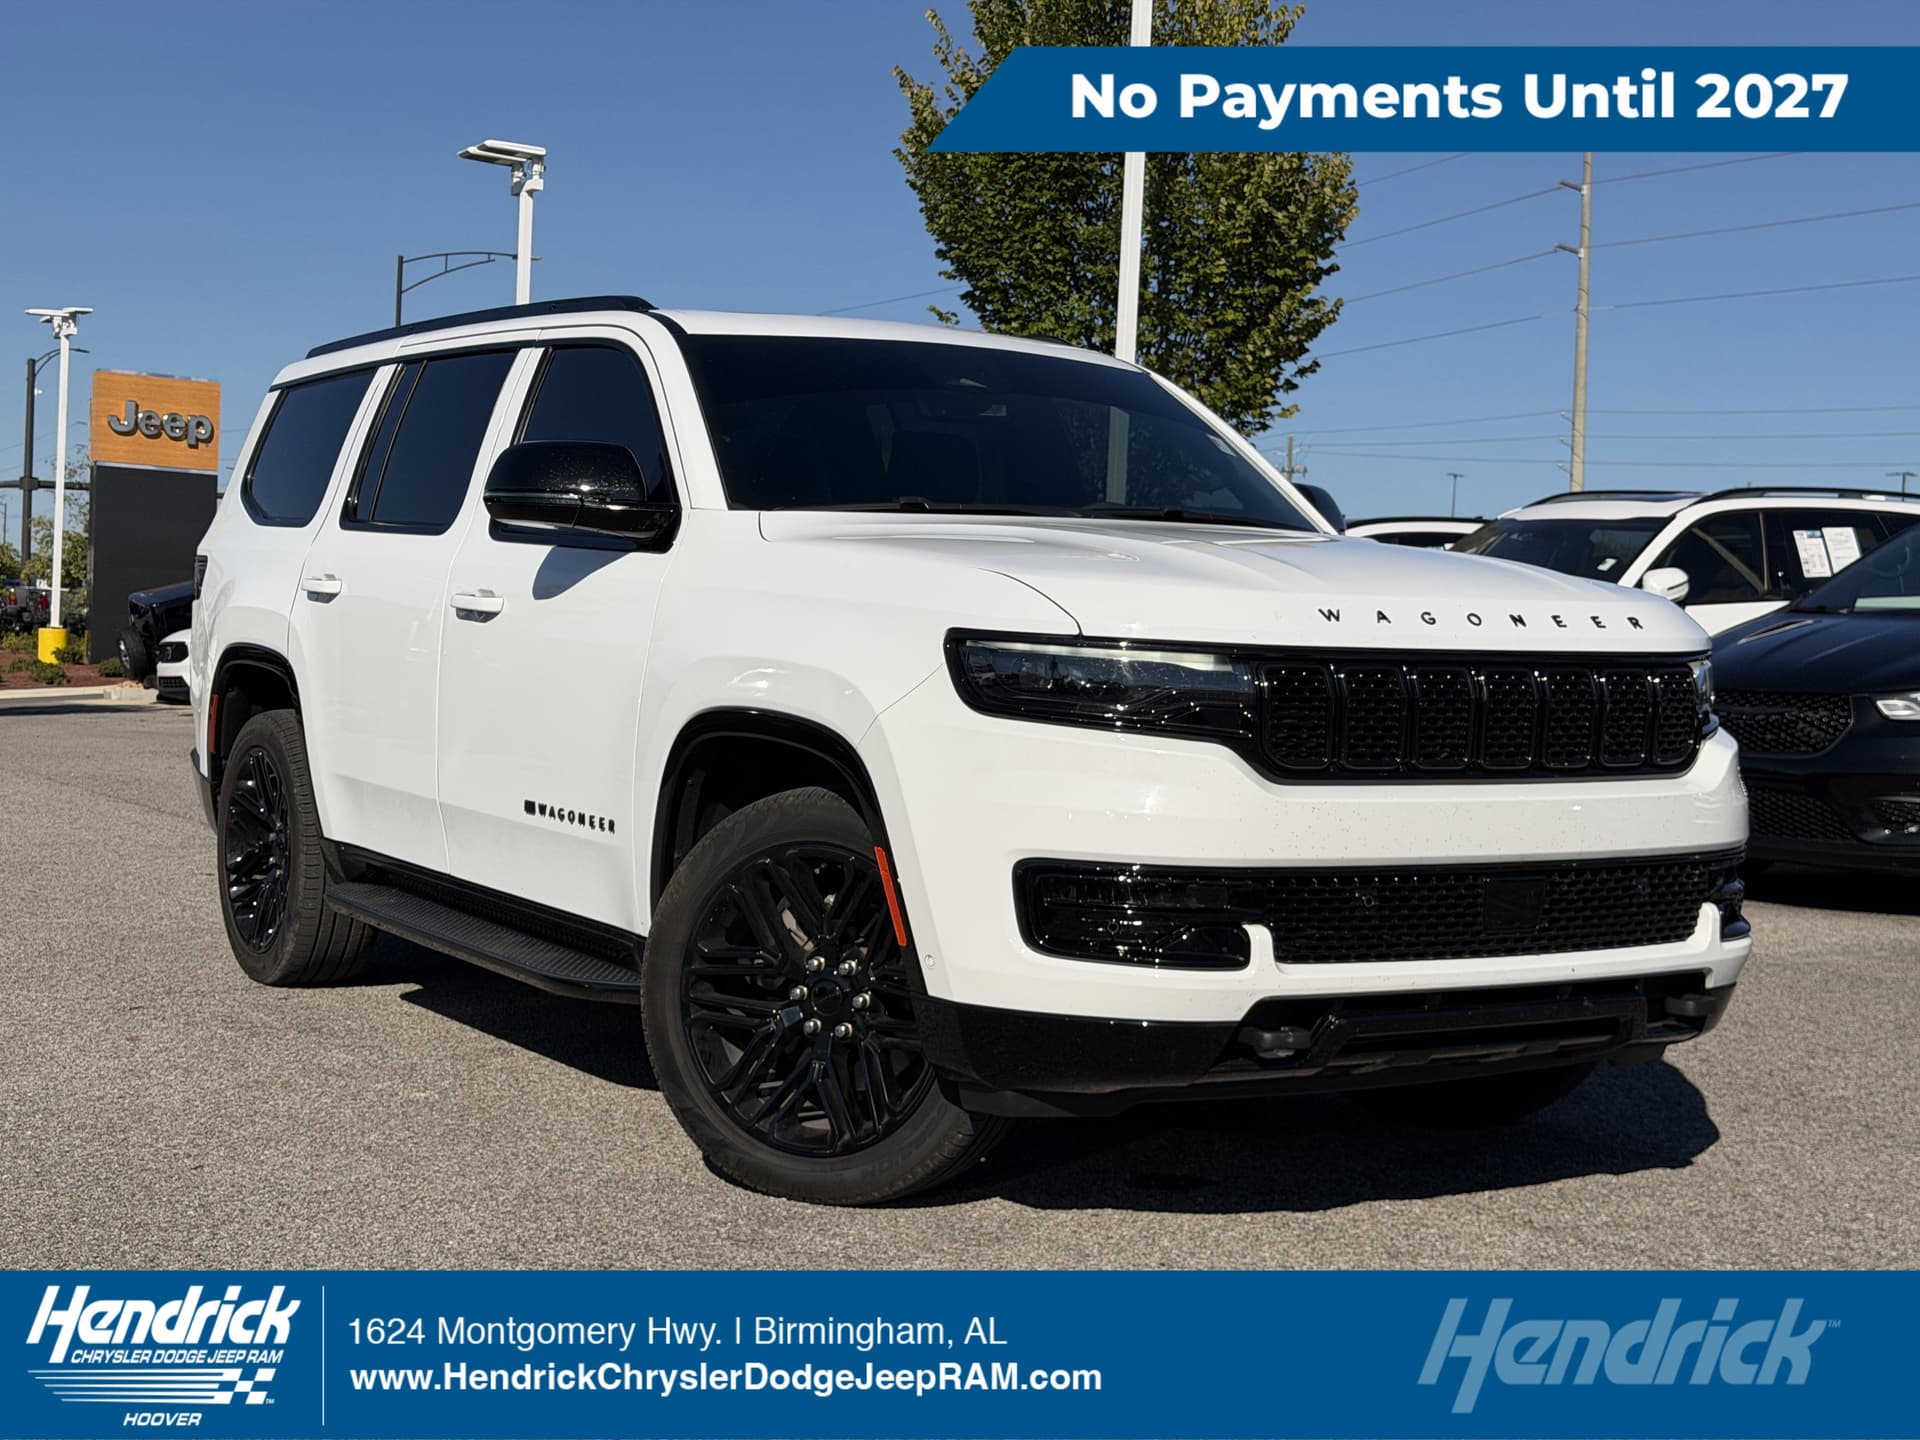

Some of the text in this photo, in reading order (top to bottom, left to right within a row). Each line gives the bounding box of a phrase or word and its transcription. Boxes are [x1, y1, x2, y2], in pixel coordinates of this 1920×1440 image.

[107, 400, 214, 450] Jeep
[1318, 608, 1643, 630] WAGONEER
[537, 802, 616, 835] WAGONEER
